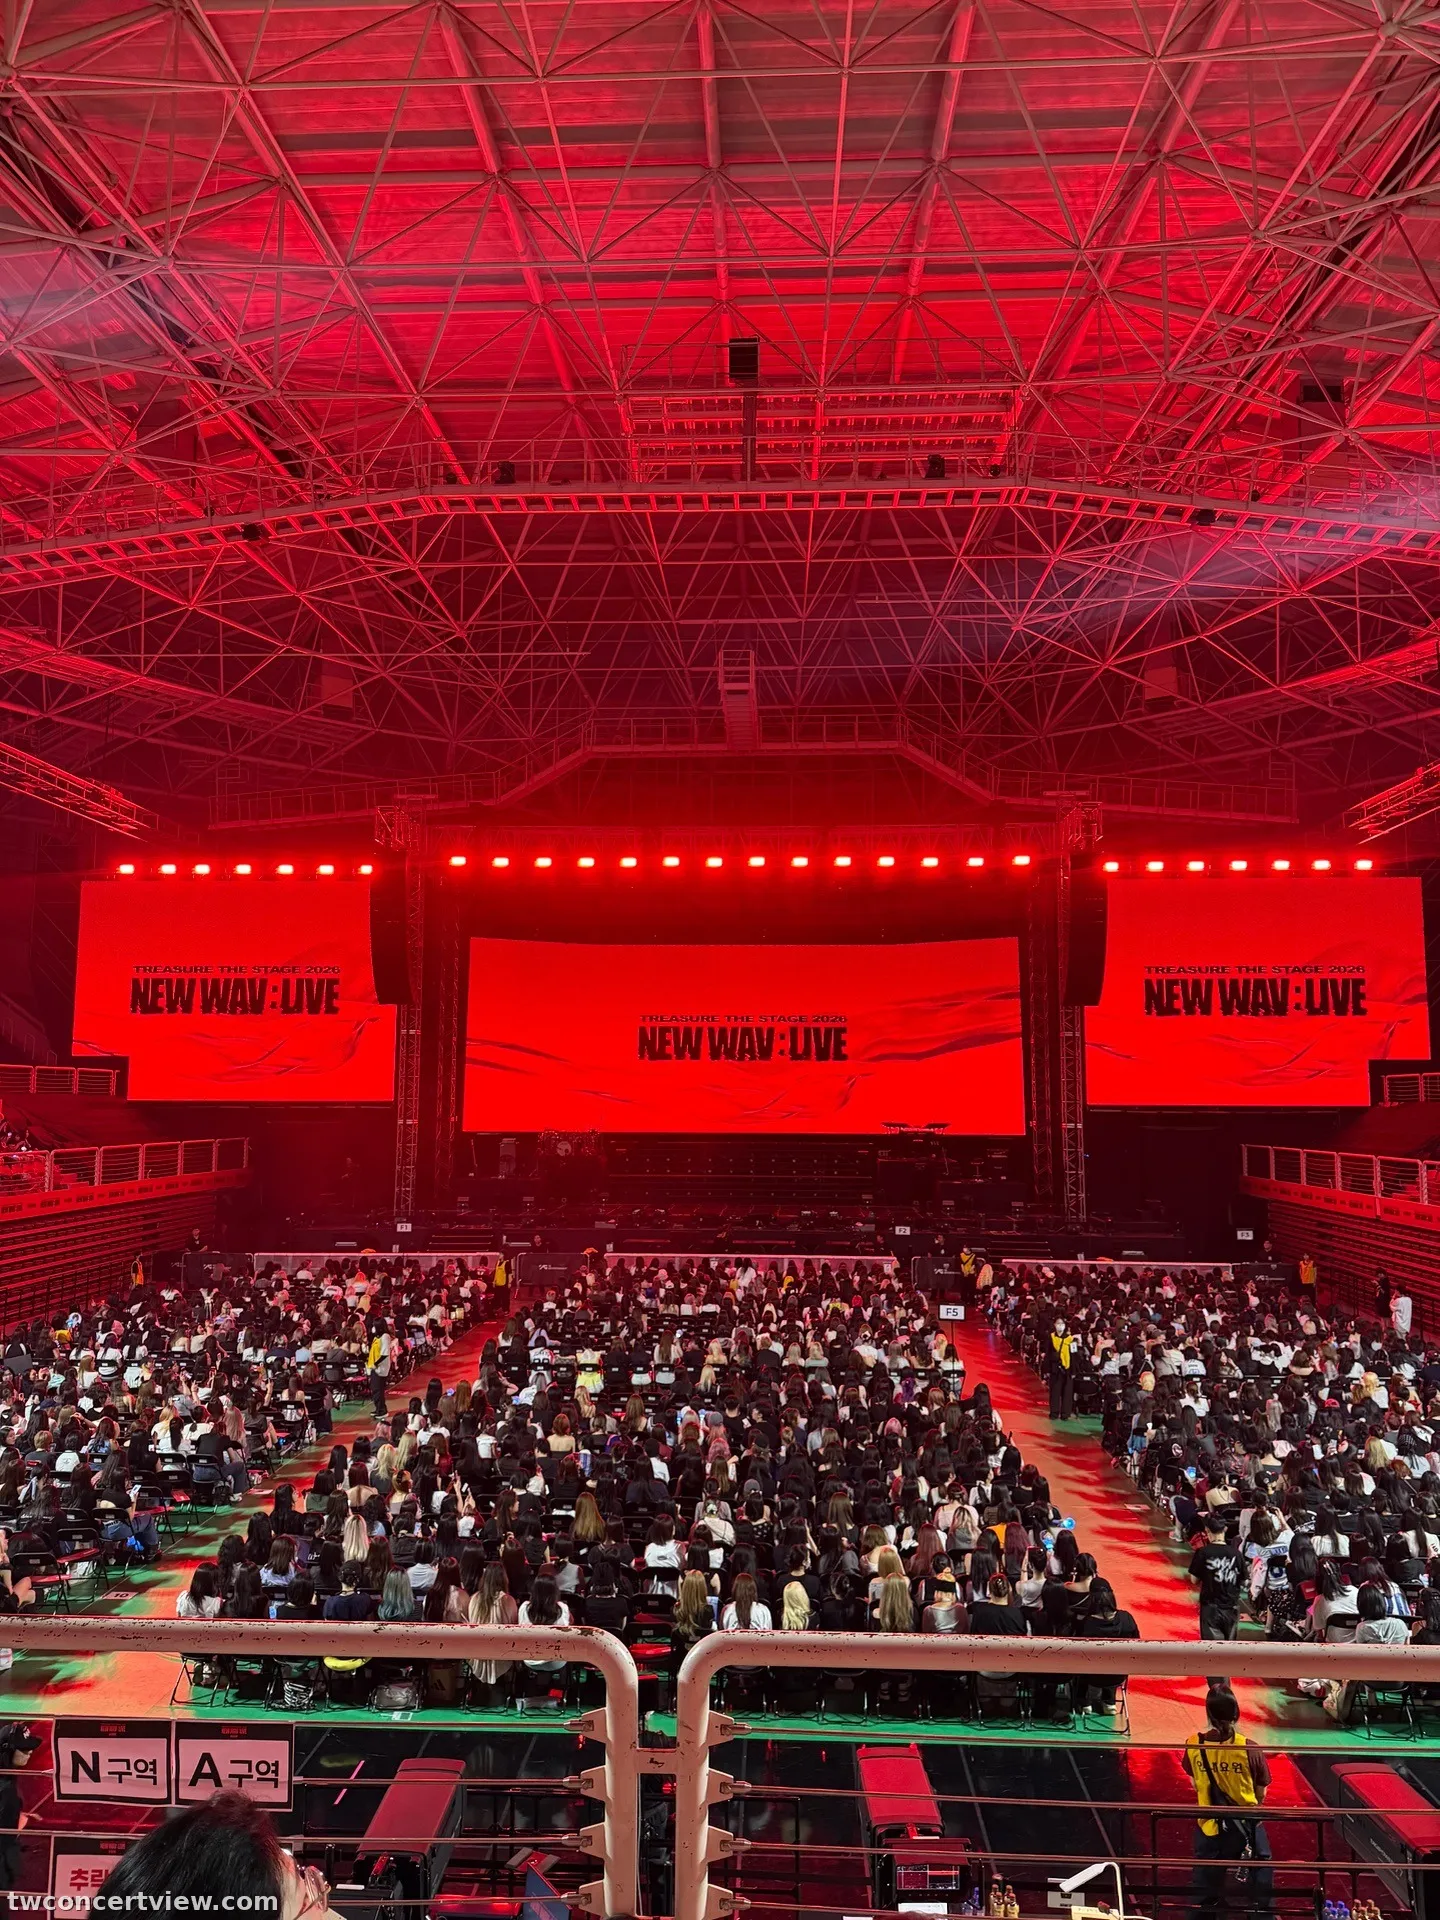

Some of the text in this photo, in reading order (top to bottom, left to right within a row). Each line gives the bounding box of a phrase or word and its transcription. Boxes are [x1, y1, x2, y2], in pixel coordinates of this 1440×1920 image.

[133, 965, 341, 974] TREASURE THE STAGE 2026
[1144, 965, 1366, 974] TREASURE THE STAGE 2026
[131, 977, 197, 1014] NEW
[1144, 978, 1213, 1016] NEW
[639, 1015, 848, 1023] TREASURE THE STAGE 2026
[638, 1026, 703, 1060] NEW
[946, 1307, 959, 1317] F5
